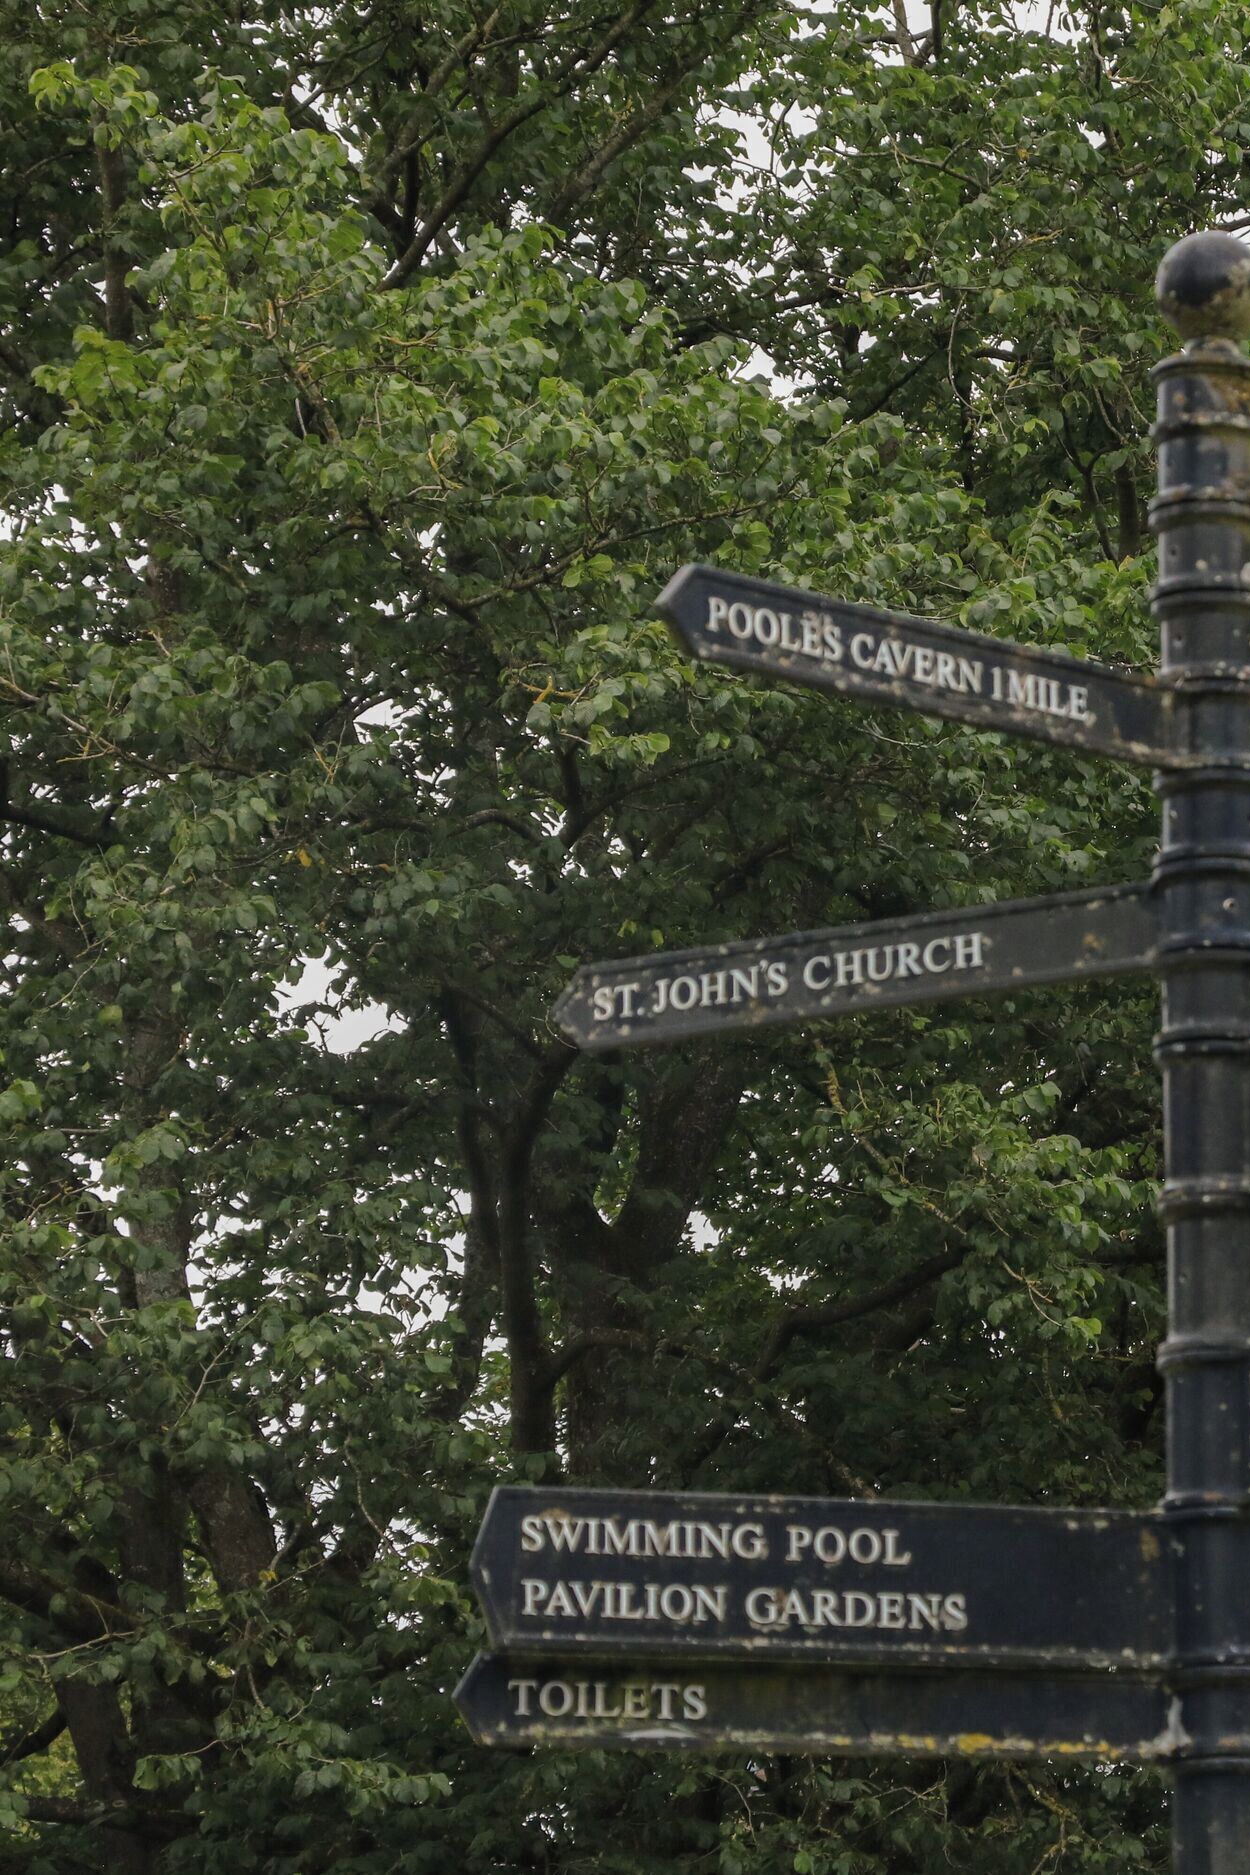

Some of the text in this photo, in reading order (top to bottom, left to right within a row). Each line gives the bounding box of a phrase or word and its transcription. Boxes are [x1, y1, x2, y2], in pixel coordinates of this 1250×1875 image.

[851, 633, 984, 693] CAVERN
[991, 666, 1001, 700] 1
[1007, 668, 1089, 721] MILE
[652, 958, 787, 1014] JOHN'S
[803, 932, 984, 990] CHURCH
[521, 1518, 911, 1566] SWIMMING POOL
[521, 1579, 967, 1630] PAVILION GARDENS
[508, 1680, 708, 1720] TOILETS
